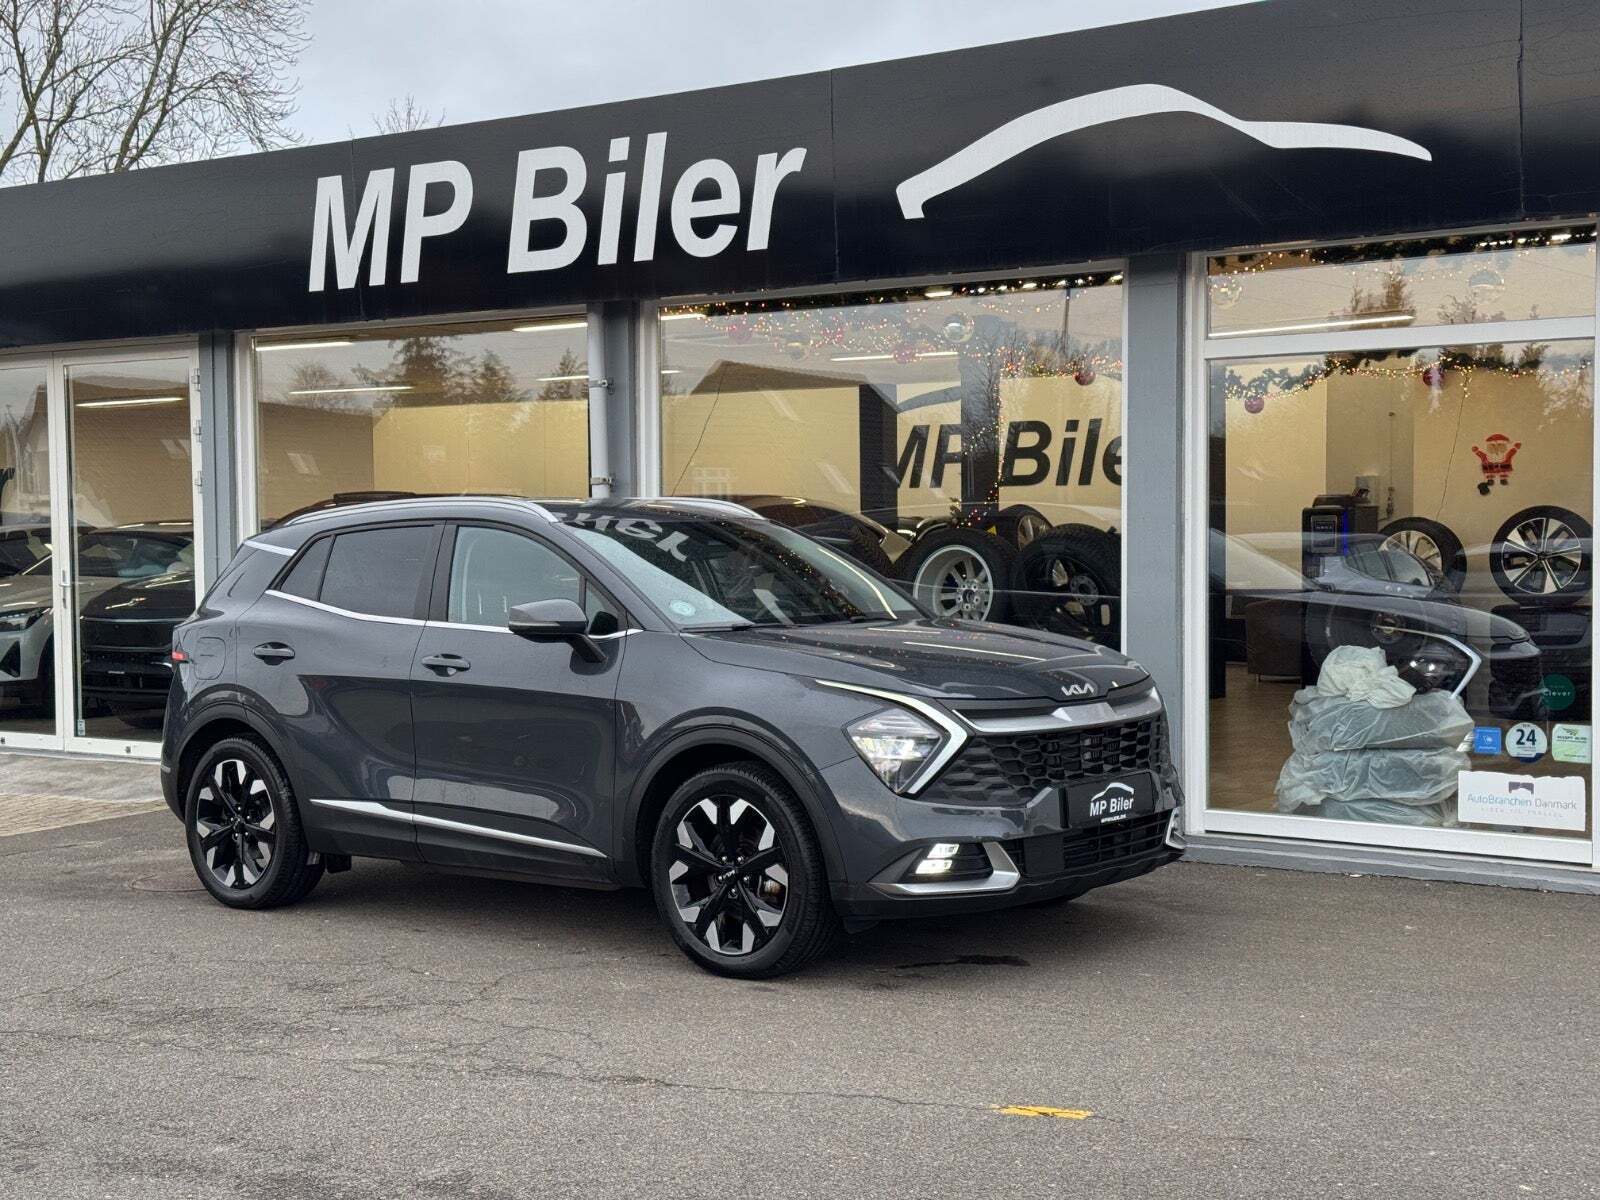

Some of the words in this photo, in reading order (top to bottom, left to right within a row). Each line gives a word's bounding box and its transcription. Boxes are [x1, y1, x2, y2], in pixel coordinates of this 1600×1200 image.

[308, 160, 474, 293] MP
[507, 132, 807, 274] Biler
[1001, 418, 1122, 487] Bile
[1515, 729, 1537, 746] 24
[1090, 800, 1107, 817] MP
[1110, 797, 1134, 813] Biler
[1467, 794, 1532, 807] AutoBranchen
[1535, 798, 1577, 810] Danmark
